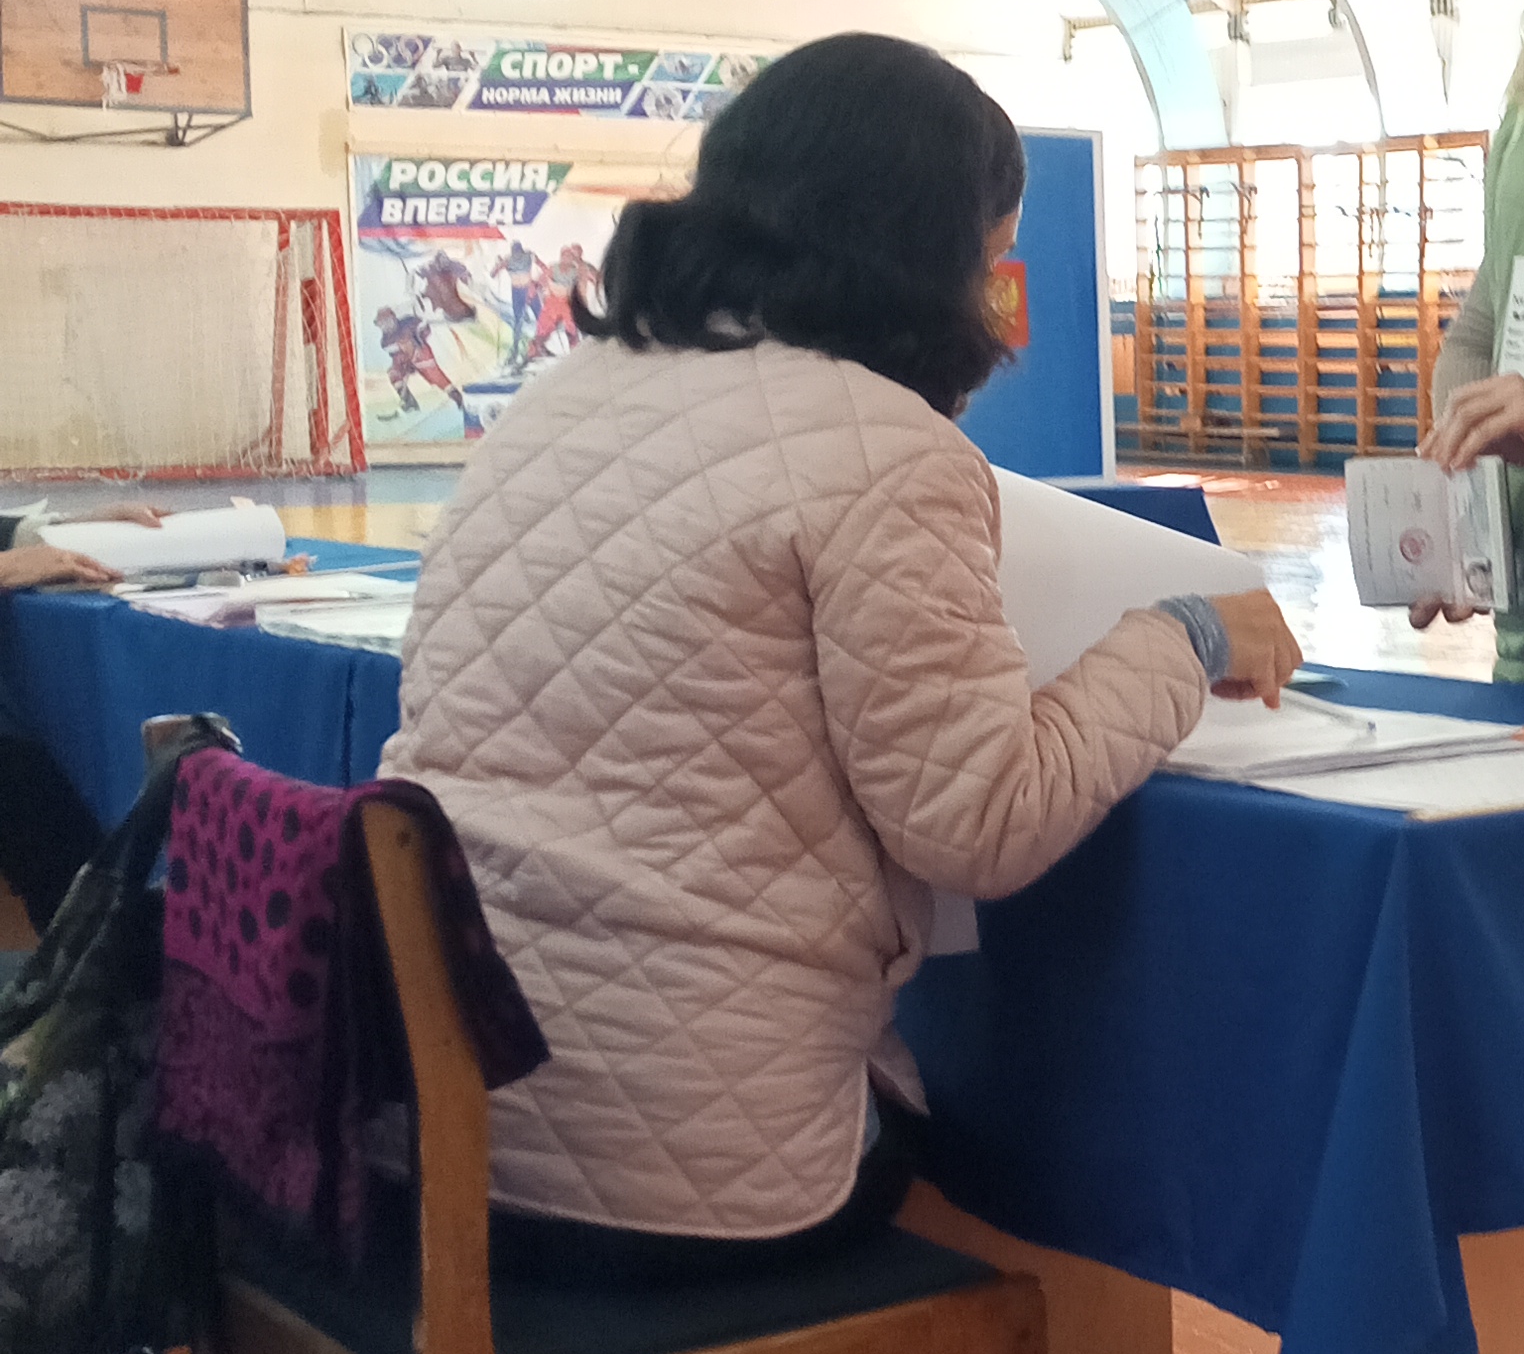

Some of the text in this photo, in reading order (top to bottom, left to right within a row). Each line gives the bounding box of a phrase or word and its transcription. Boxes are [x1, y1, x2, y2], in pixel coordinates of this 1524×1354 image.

[500, 51, 623, 80] СПОРТ
[481, 86, 623, 105] НОРМА ЖИЗНИ
[389, 159, 557, 195] РОССИЯ,
[381, 196, 526, 226] ВПЕРЕД!
